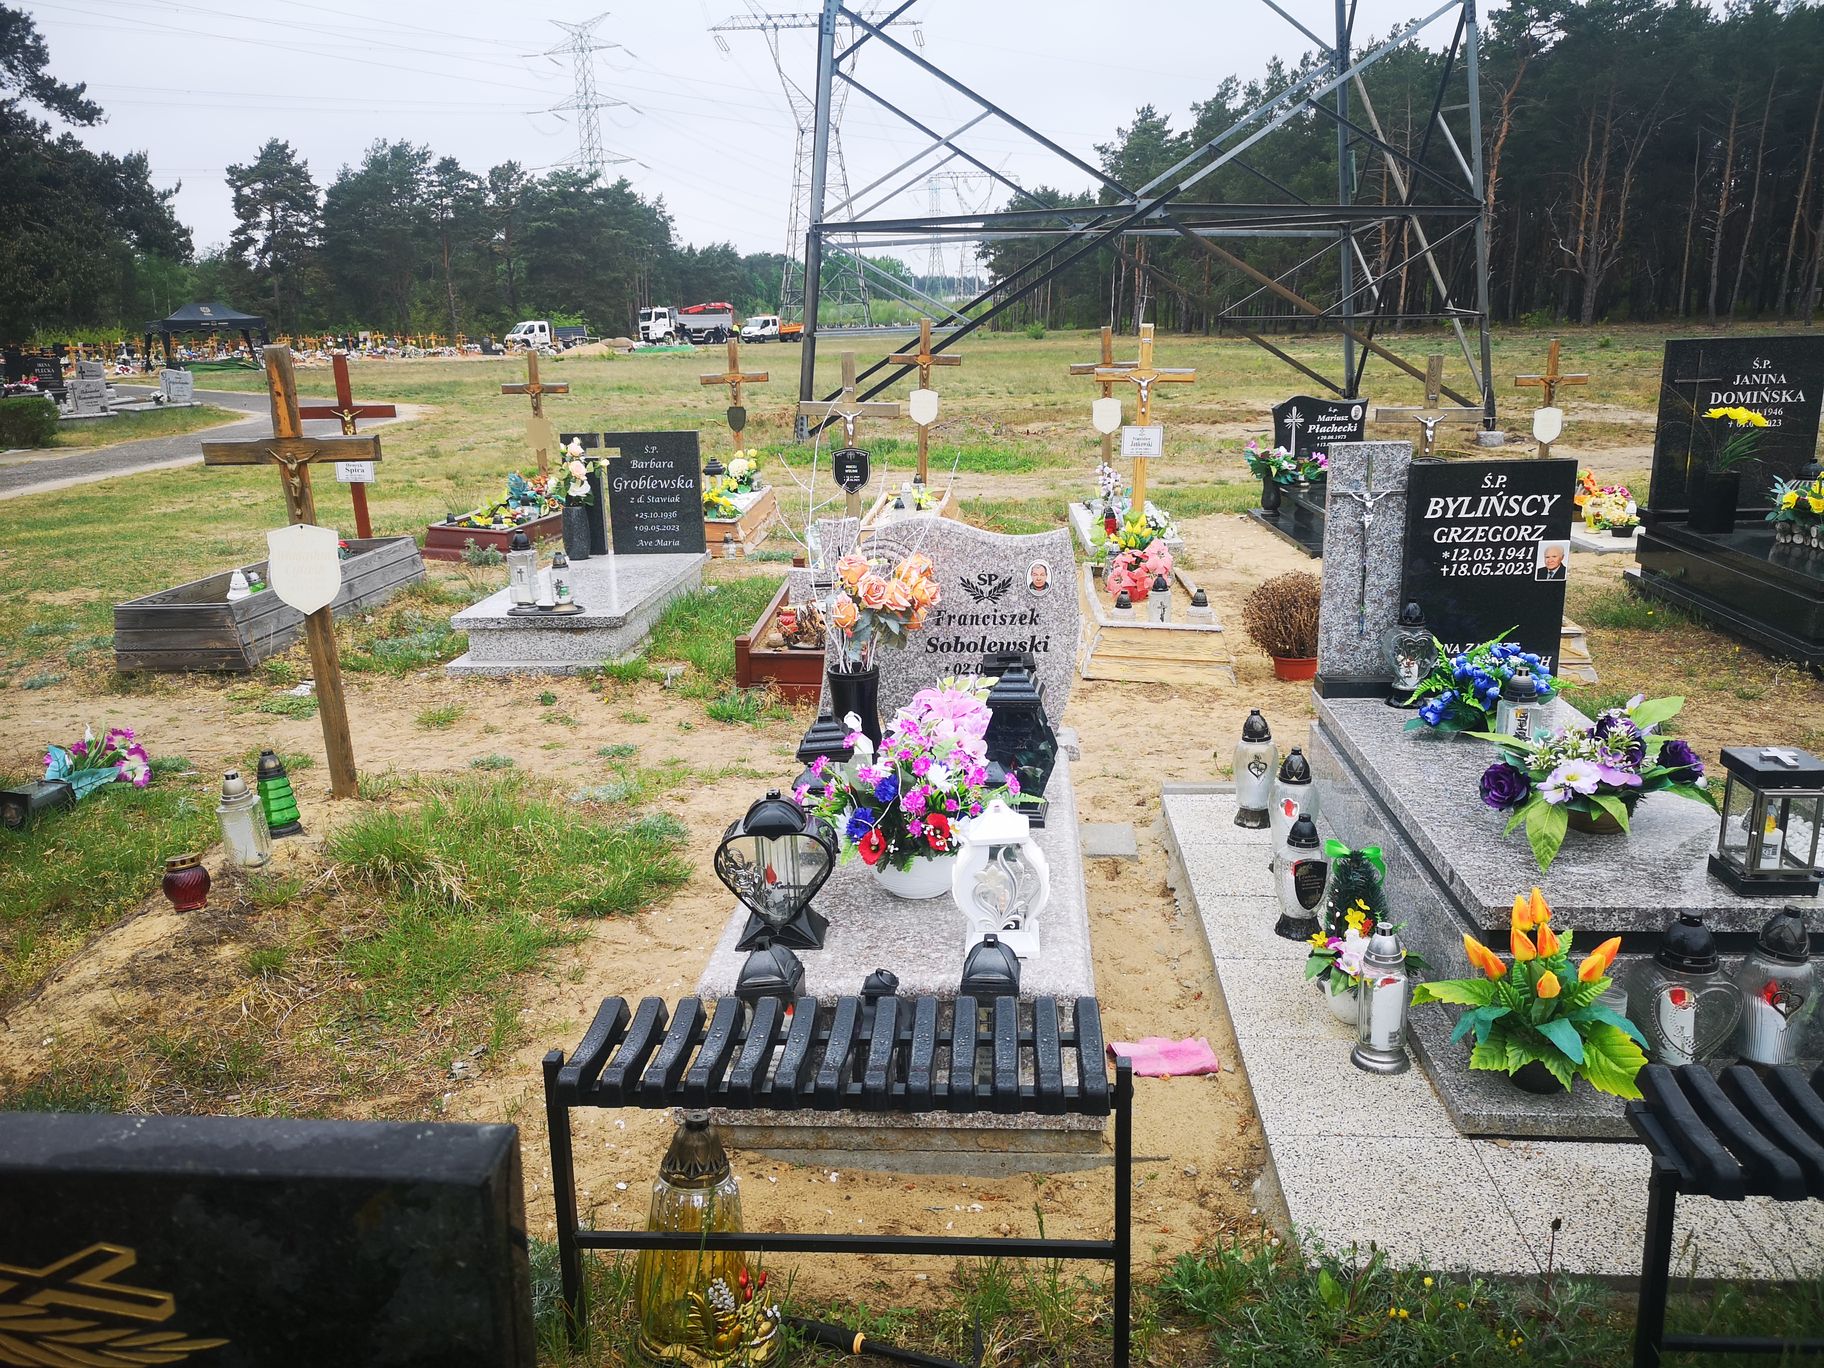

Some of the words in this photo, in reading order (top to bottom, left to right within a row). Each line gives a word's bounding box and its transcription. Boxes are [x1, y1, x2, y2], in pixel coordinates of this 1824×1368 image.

[1732, 373, 1787, 385] JANINA
[1709, 387, 1806, 404] DOMIŃSKA
[1317, 414, 1349, 422] Mariusz
[1307, 422, 1358, 433] Płachecki
[630, 458, 674, 469] Barbara
[613, 475, 695, 492] Groblewska
[1481, 472, 1508, 488] Ś.P.
[647, 494, 681, 503] Stawiak
[1424, 491, 1562, 519] BYLIŃSCY
[1433, 525, 1547, 543] GRZEGORZ
[636, 539, 653, 547] Ave
[654, 539, 680, 547] Maria
[935, 608, 1041, 627] Franciszek
[925, 635, 1051, 653] Sobolewski
